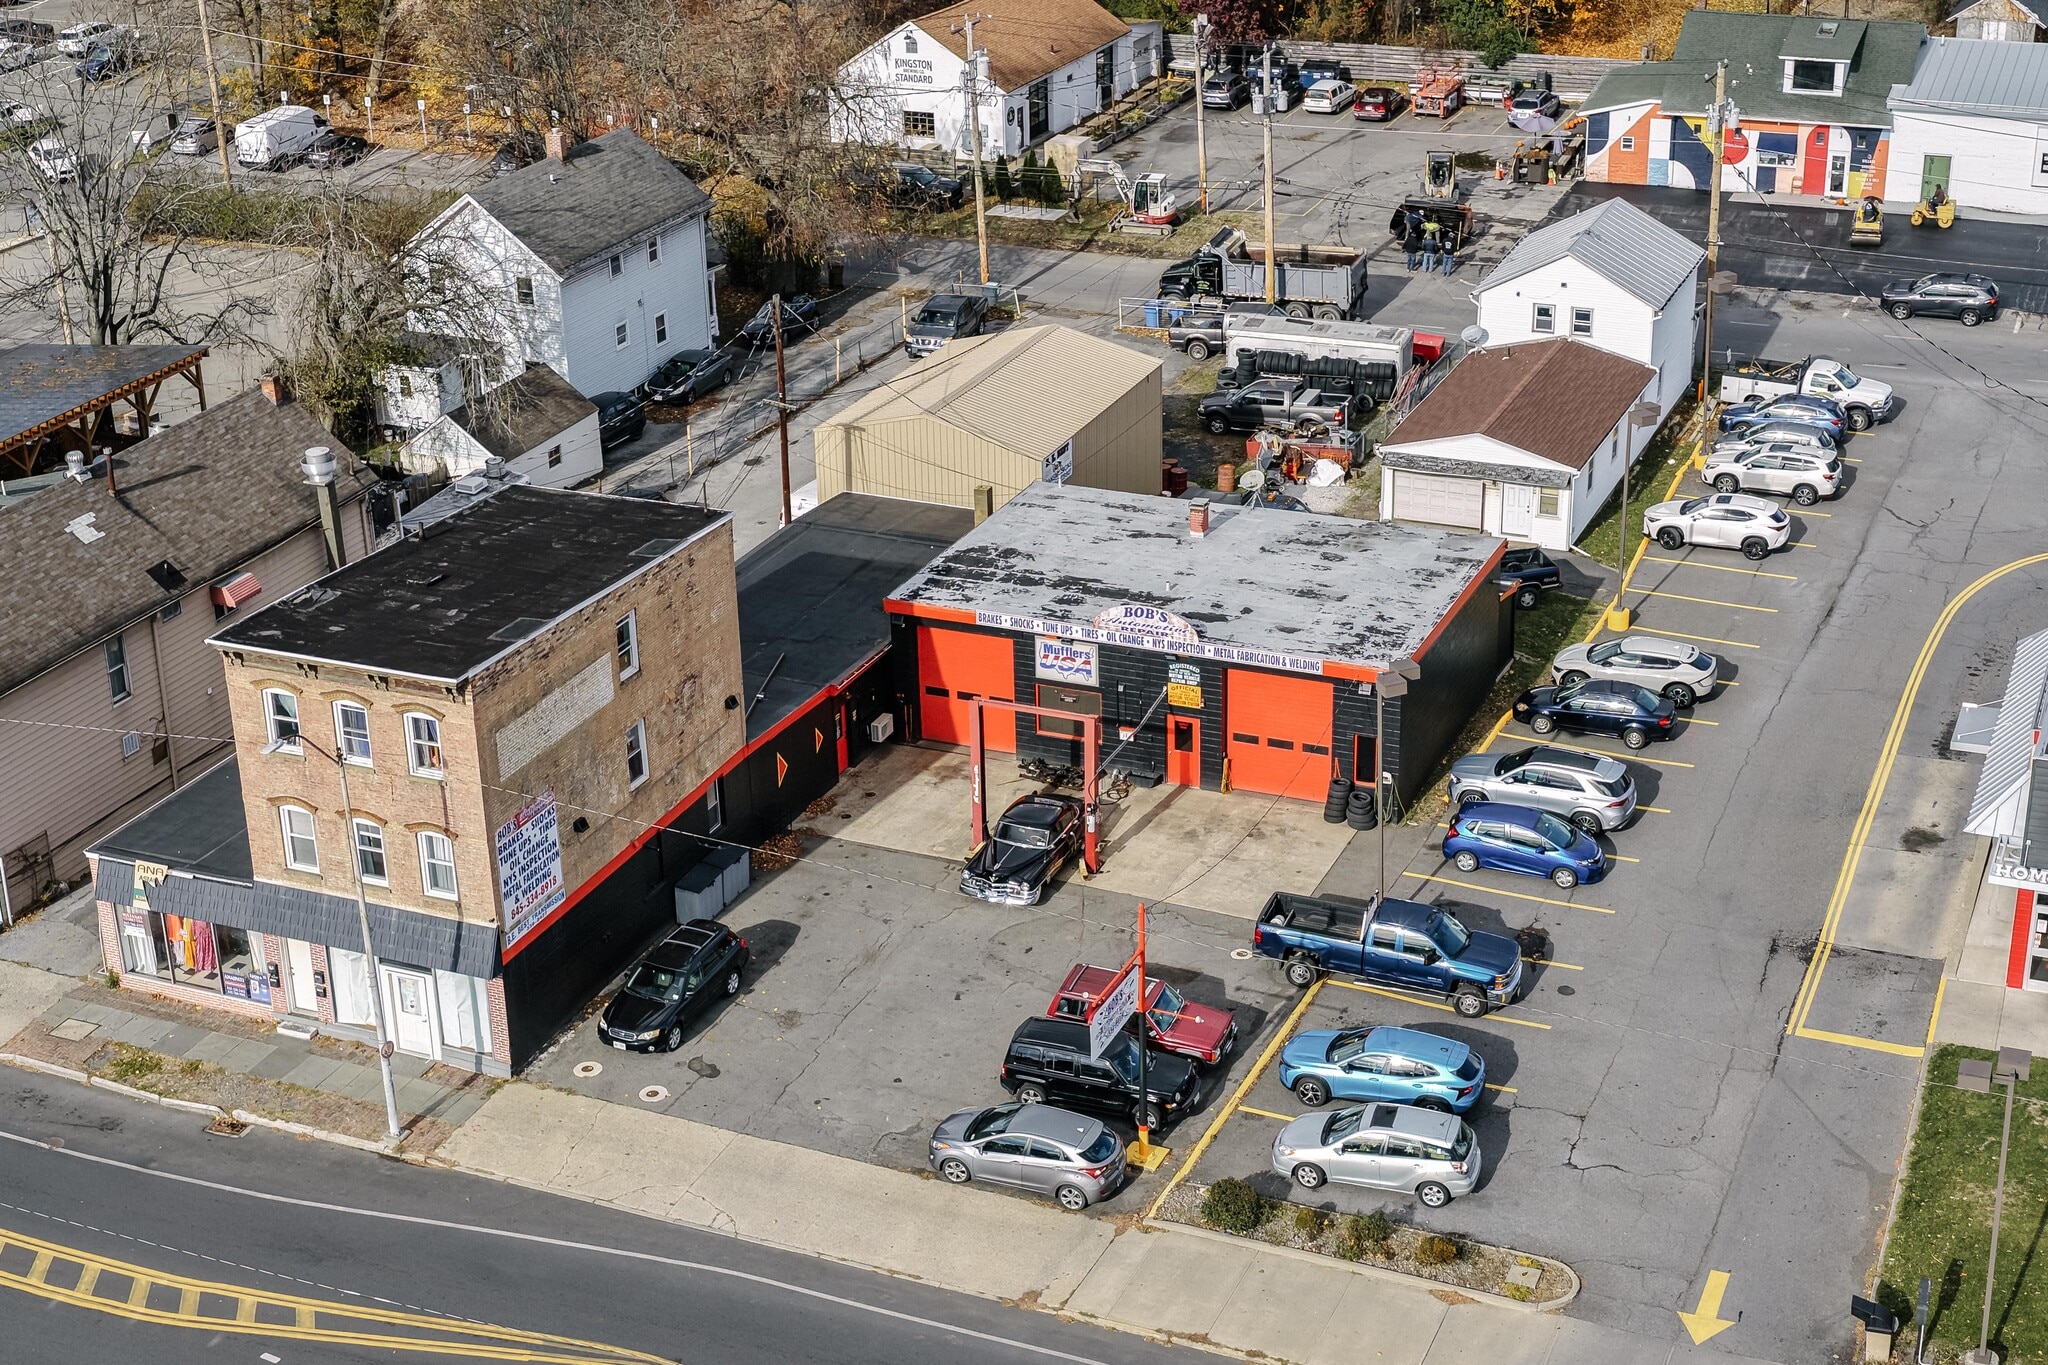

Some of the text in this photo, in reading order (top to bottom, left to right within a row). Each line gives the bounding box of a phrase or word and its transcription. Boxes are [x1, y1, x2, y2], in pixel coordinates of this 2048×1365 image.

[895, 58, 932, 71] KINGSTON
[895, 73, 933, 84] STANDARD
[1101, 617, 1190, 634] Automotive
[1123, 607, 1168, 622] BOB'S
[978, 612, 1320, 672] BRAKES SHOCKS TUNE UPS TIRES OIL CHANGE NYS INSPECTION METAL FABRICATION & WELDING
[1120, 626, 1169, 637] REPAIR
[1043, 643, 1091, 660] Mufflers
[1040, 654, 1092, 676] USA
[1169, 663, 1200, 674] REGISTERED
[1171, 685, 1198, 694] OFFICIAL
[497, 829, 524, 856] BRAKES
[531, 804, 555, 831] SHOCKS
[497, 818, 518, 843] BOB'S
[499, 815, 556, 867] TUNE UPS TIRES
[509, 833, 549, 871] OIL CHANGE
[137, 864, 164, 877] ANA
[503, 838, 557, 889] NYS INSPECTION
[1994, 863, 2048, 885] HOM
[503, 849, 560, 901] METAL FABRICATION
[514, 867, 552, 905] & WELDING
[510, 875, 557, 920] 845-334-8918
[517, 919, 530, 934] BEST
[531, 890, 565, 921] TRANSMISSION
